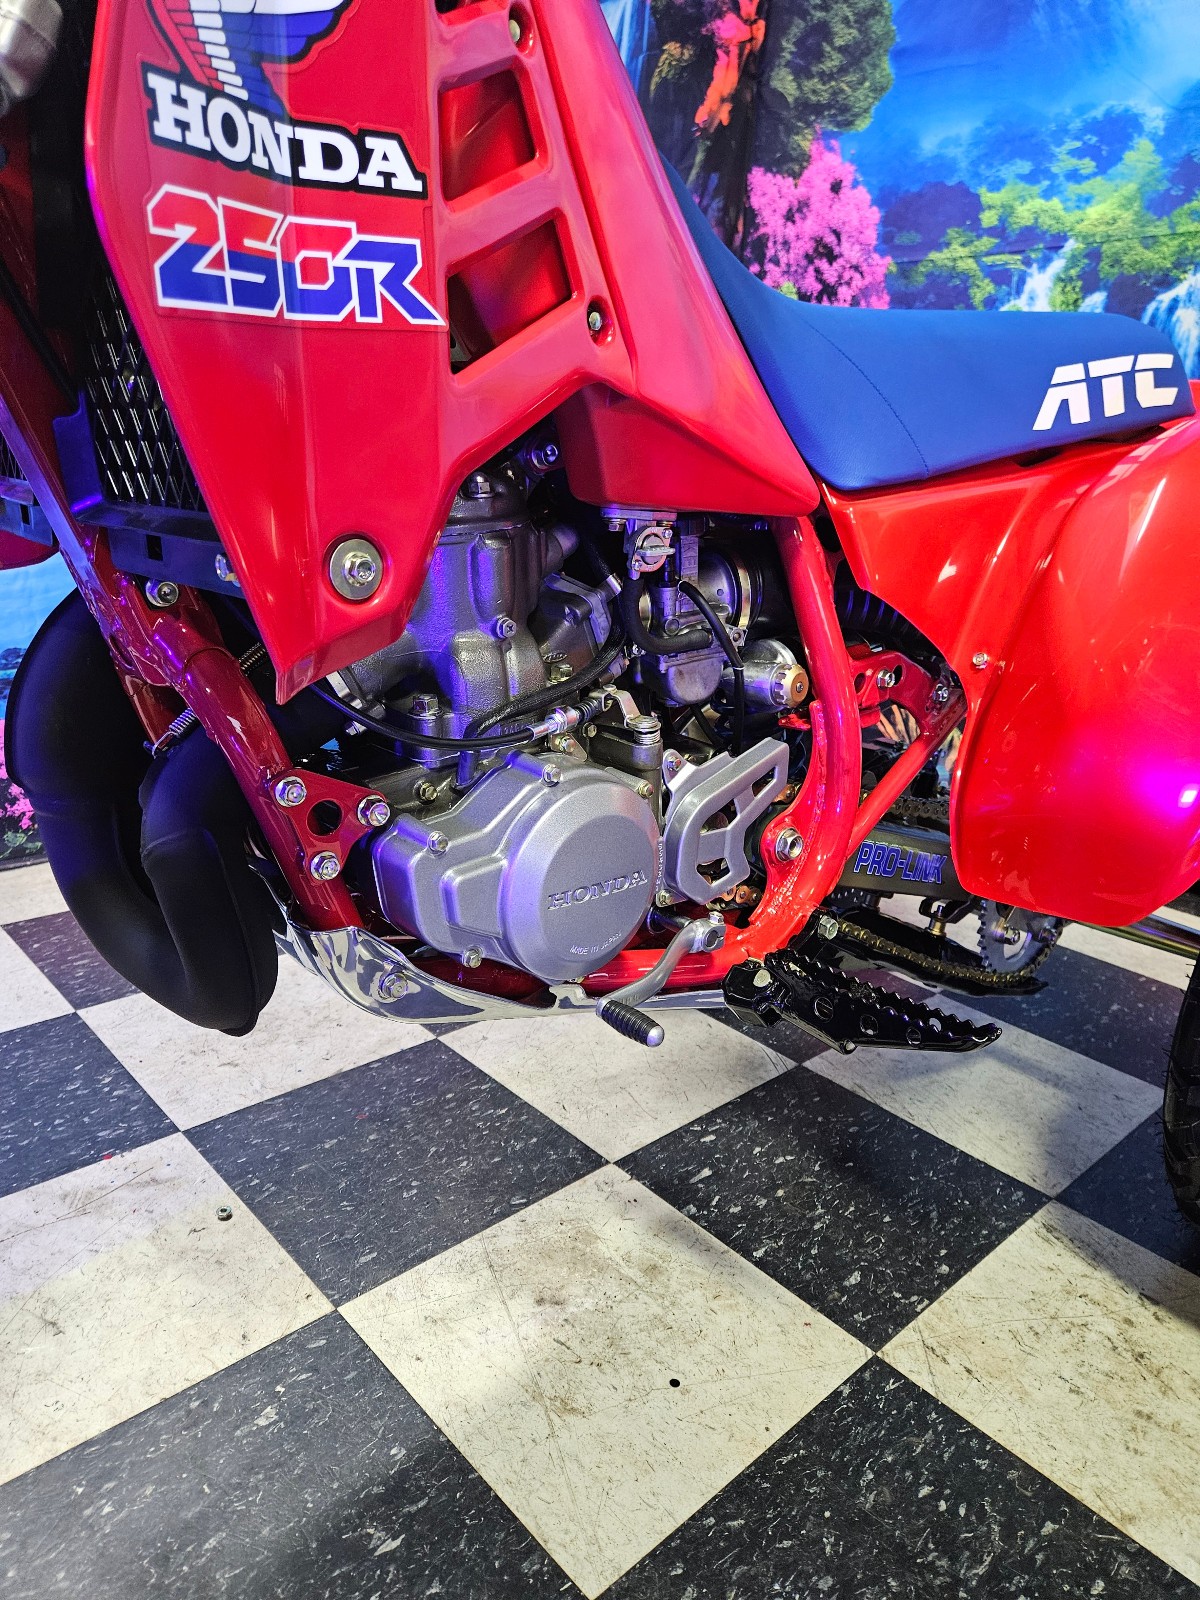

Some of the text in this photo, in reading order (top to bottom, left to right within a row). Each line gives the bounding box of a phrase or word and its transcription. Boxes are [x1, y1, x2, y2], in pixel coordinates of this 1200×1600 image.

[147, 73, 423, 192] HONDA
[147, 184, 447, 326] 250R
[1032, 353, 1179, 431] ATC
[547, 869, 648, 911] HONDA
[853, 840, 947, 884] PRO-LINK
